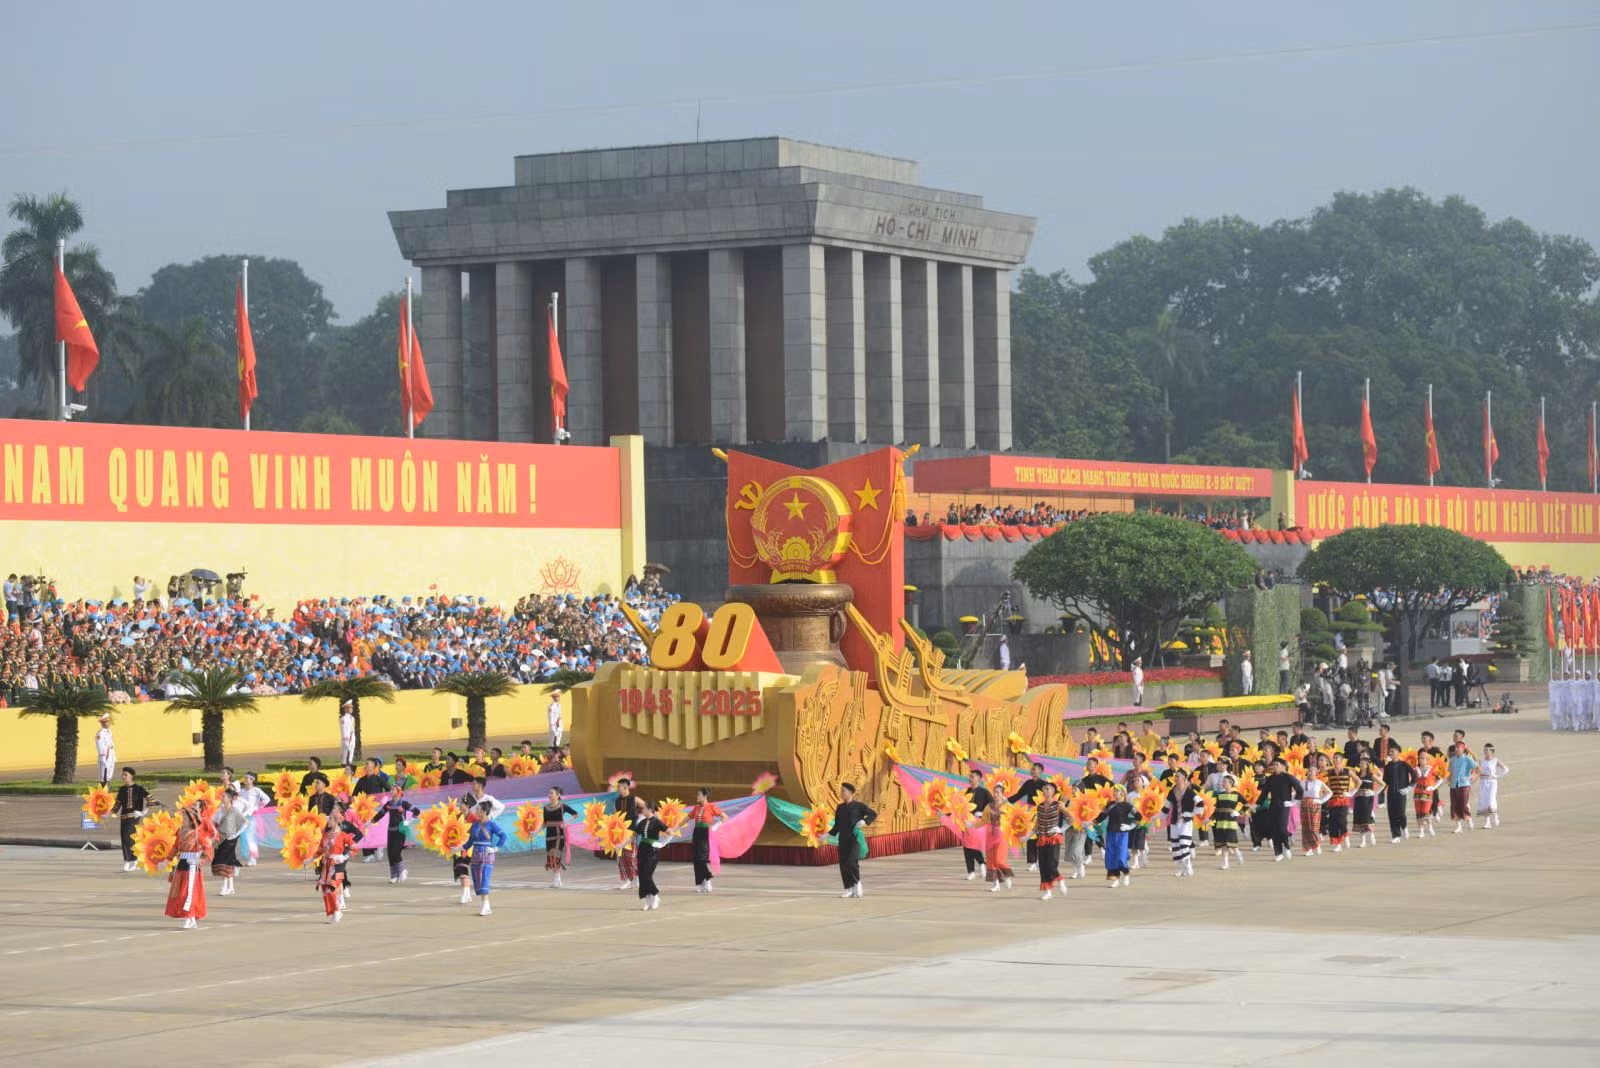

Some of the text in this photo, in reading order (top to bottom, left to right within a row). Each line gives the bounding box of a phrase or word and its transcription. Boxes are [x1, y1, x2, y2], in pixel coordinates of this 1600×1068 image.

[4, 443, 85, 505] NAM
[108, 447, 230, 512] QUANG
[250, 453, 330, 510] VINH
[351, 449, 438, 513] MUÔN
[457, 452, 517, 514] NĂM
[1015, 466, 1035, 483] TINH
[1308, 488, 1346, 530] NƯỚC
[1395, 491, 1419, 528] HÒA
[1425, 493, 1441, 528] XÃ
[1474, 491, 1497, 533] CHỦ
[1503, 496, 1538, 534] NGHĨA
[1542, 497, 1566, 540] VIỆT
[1571, 502, 1593, 535] NAM
[651, 602, 756, 669] 80
[618, 687, 674, 716] 1945
[700, 688, 762, 717] 2025
